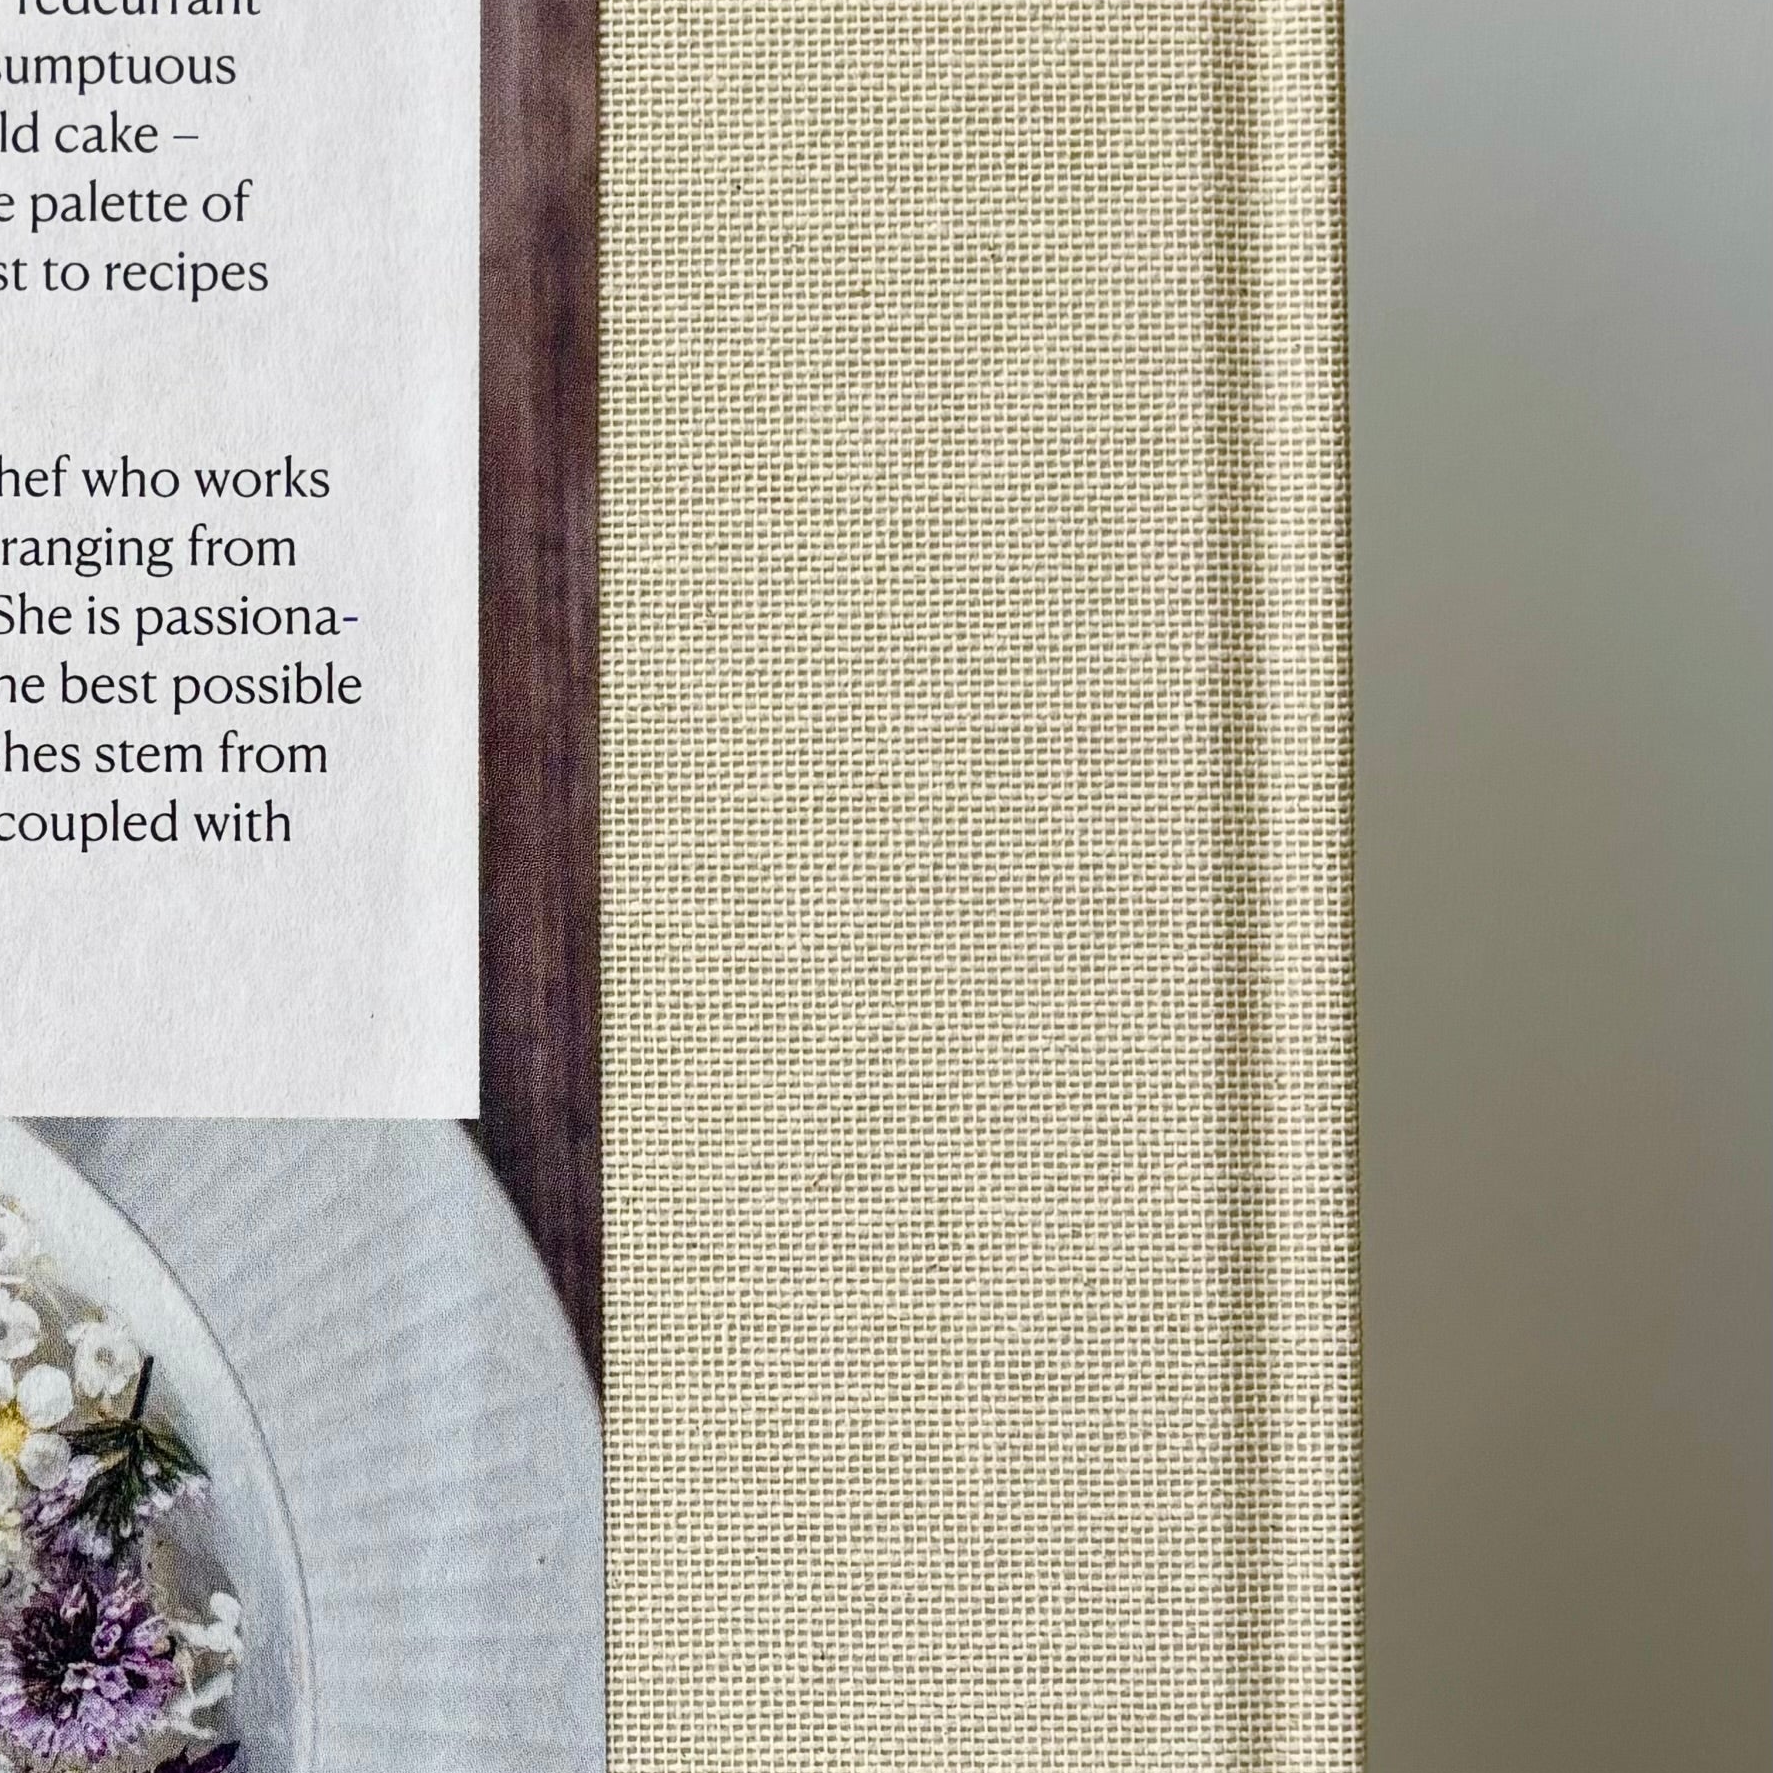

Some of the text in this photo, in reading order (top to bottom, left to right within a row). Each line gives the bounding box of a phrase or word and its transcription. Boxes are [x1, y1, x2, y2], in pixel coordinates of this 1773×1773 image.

[54, 109, 159, 154] cake
[29, 178, 188, 234] palette
[201, 178, 254, 223] of
[42, 257, 91, 292] to
[104, 250, 269, 303] recipes
[81, 454, 180, 499] who
[193, 454, 331, 499] works
[1, 526, 175, 579] ranging
[187, 522, 296, 567] from
[86, 594, 121, 636] is
[135, 595, 359, 647] passiona-
[59, 659, 158, 705] best
[172, 660, 363, 716] possible
[94, 739, 204, 774] stem
[218, 728, 328, 774] from
[193, 798, 291, 843] with
